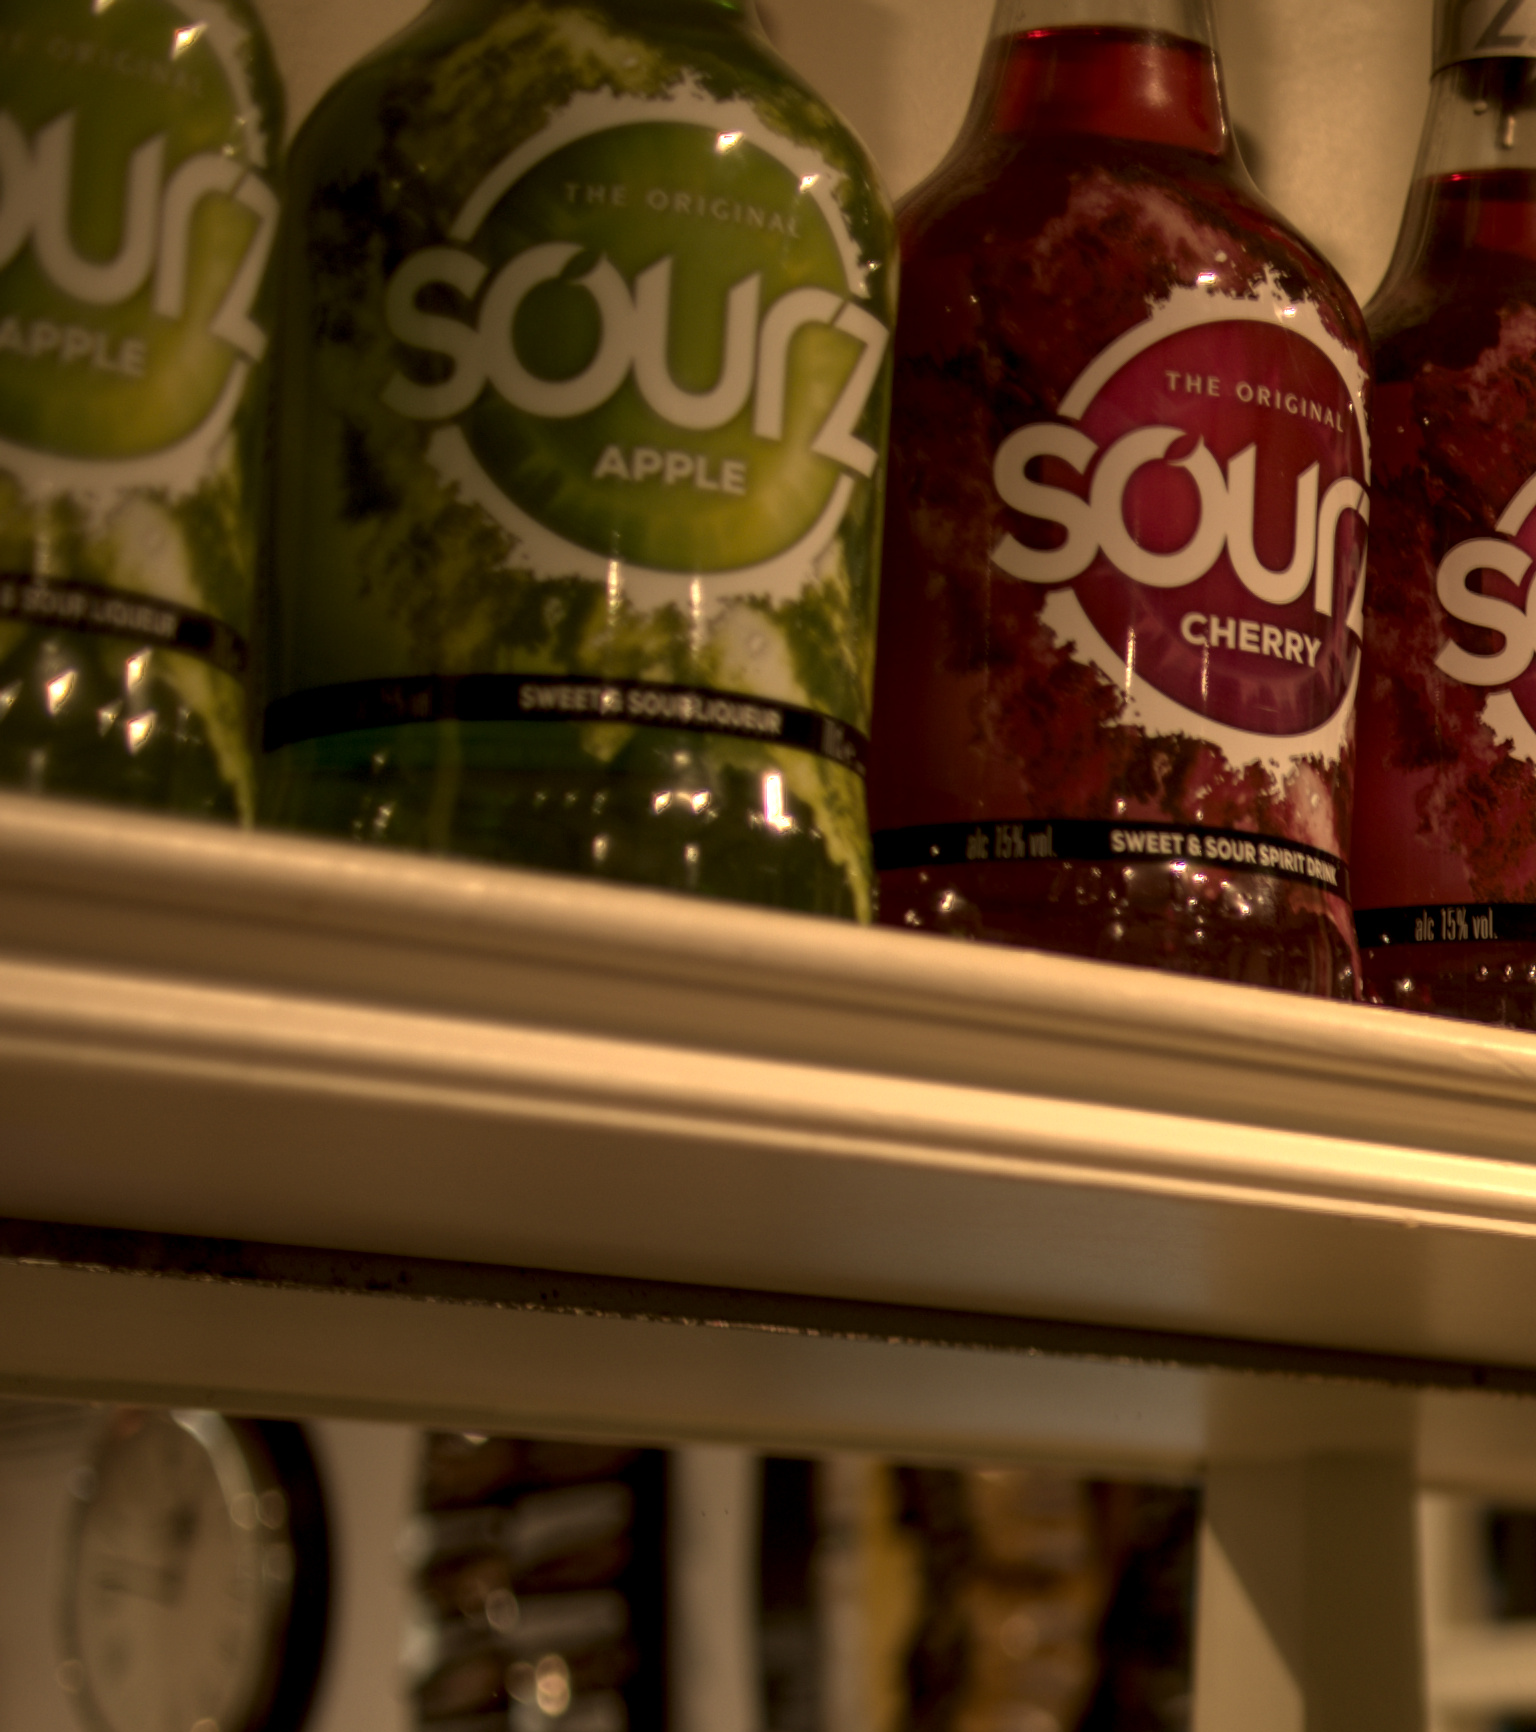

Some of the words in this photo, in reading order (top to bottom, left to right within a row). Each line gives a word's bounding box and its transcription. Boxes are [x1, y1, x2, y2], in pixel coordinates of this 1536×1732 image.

[565, 182, 628, 206] THE
[645, 186, 801, 239] ORIGINAL
[1164, 369, 1221, 398] THE
[1235, 381, 1345, 434] ORIGINAL
[594, 444, 748, 496] APPLE
[990, 422, 1370, 617] SOUR
[1181, 611, 1322, 670] CHERRY
[1110, 828, 1185, 857] SWEET
[1186, 832, 1202, 857] &
[1205, 836, 1256, 866] SOUR
[1258, 842, 1305, 876] SPIRIT
[1306, 853, 1338, 887] DRINK
[1415, 912, 1435, 942] alc
[1441, 908, 1469, 941] 15%
[1472, 908, 1499, 941] vol.
